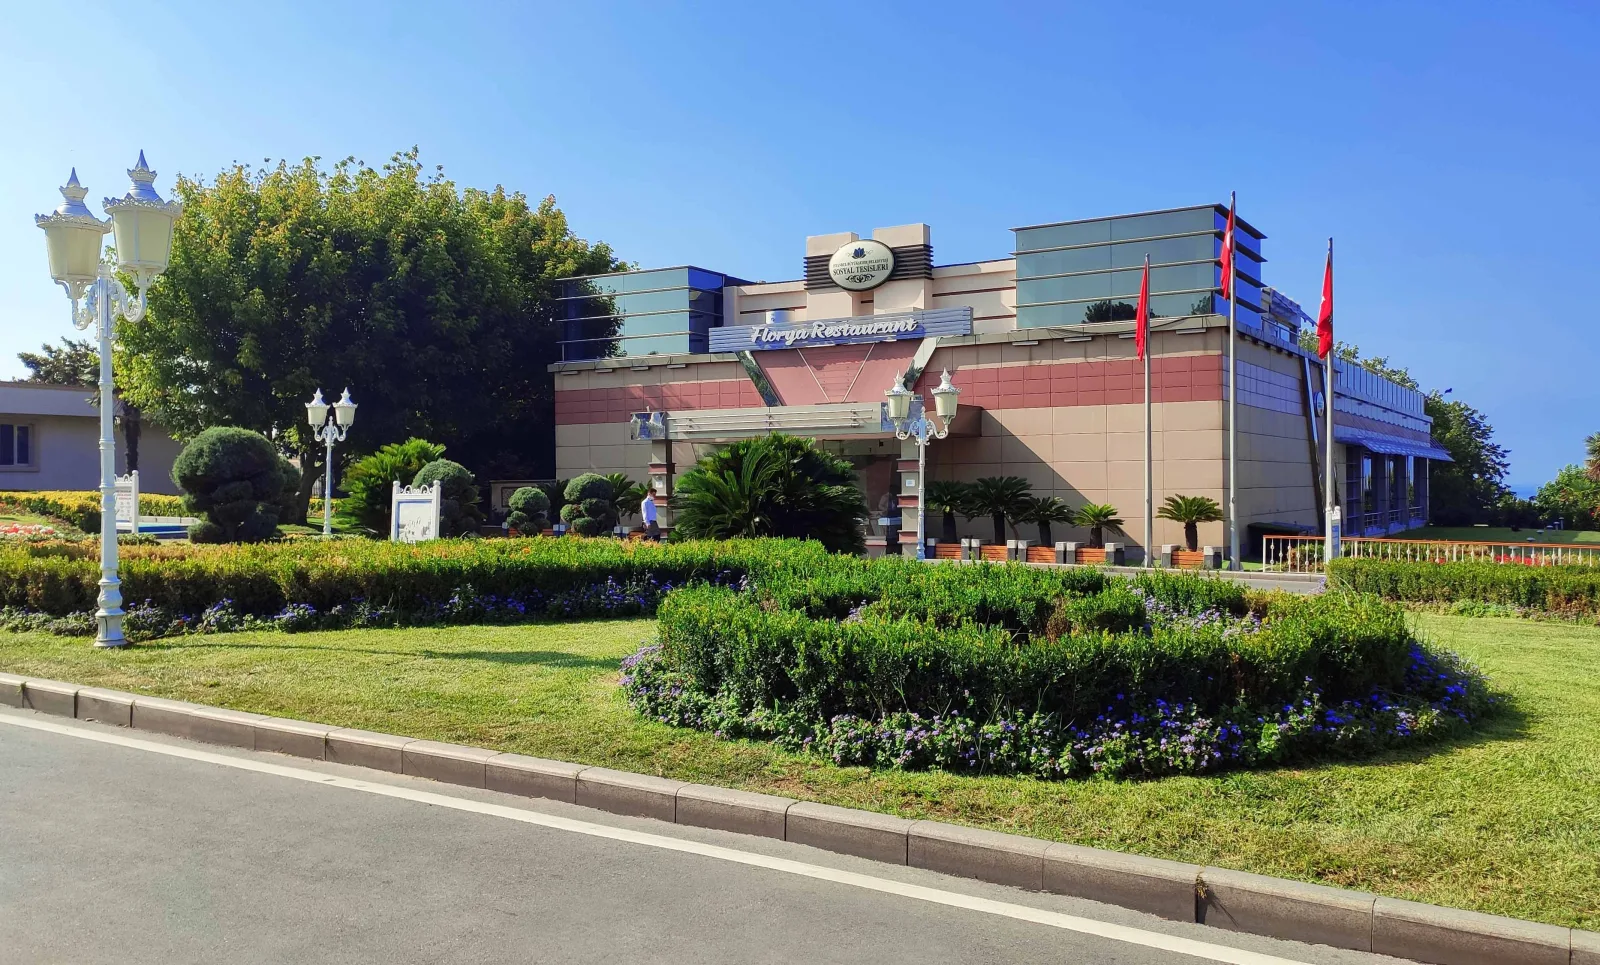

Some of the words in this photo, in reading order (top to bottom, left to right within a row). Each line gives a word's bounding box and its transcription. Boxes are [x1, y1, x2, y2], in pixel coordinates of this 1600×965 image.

[833, 267, 855, 276] SOSYAL
[751, 326, 809, 346] Florya
[811, 318, 918, 339] Restaurant
